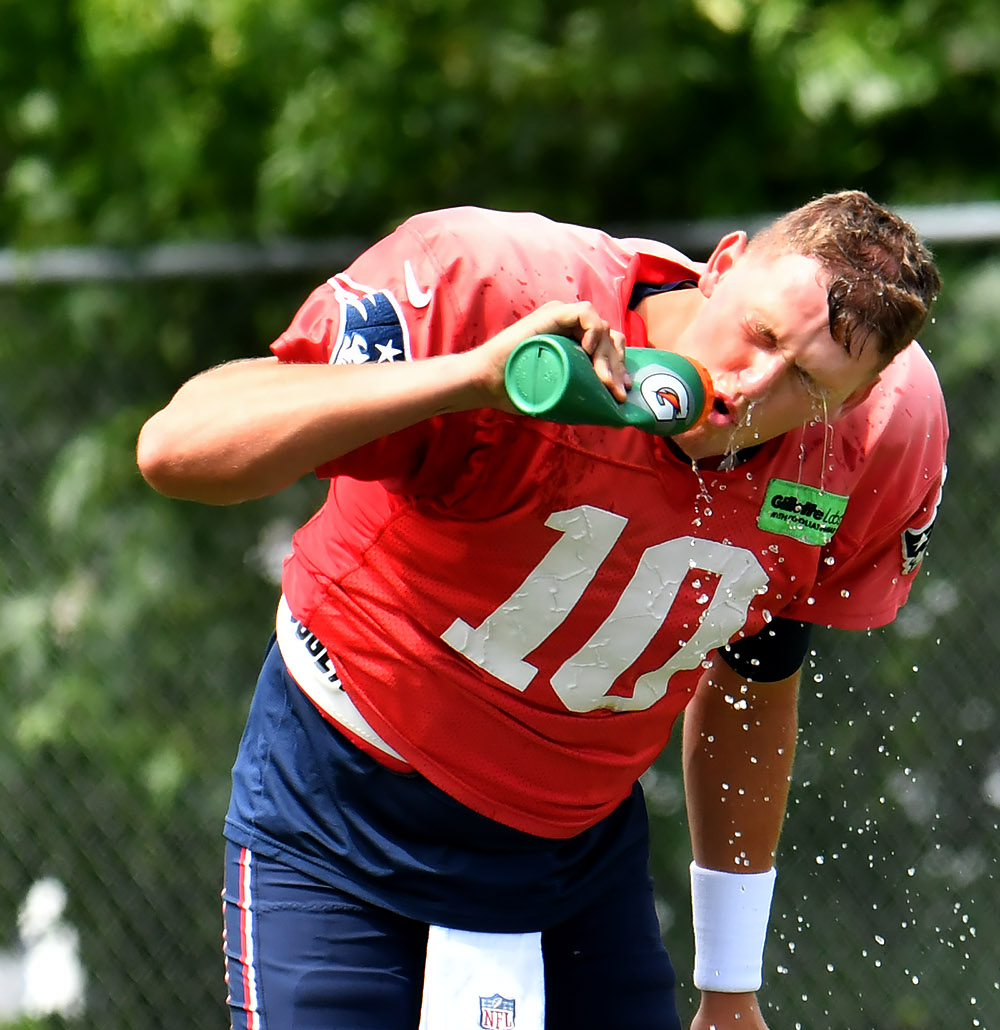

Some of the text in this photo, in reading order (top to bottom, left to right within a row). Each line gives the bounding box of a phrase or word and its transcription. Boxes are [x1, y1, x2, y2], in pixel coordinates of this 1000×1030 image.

[640, 372, 689, 421] G
[440, 504, 769, 713] 10
[484, 1009, 512, 1030] NFL
